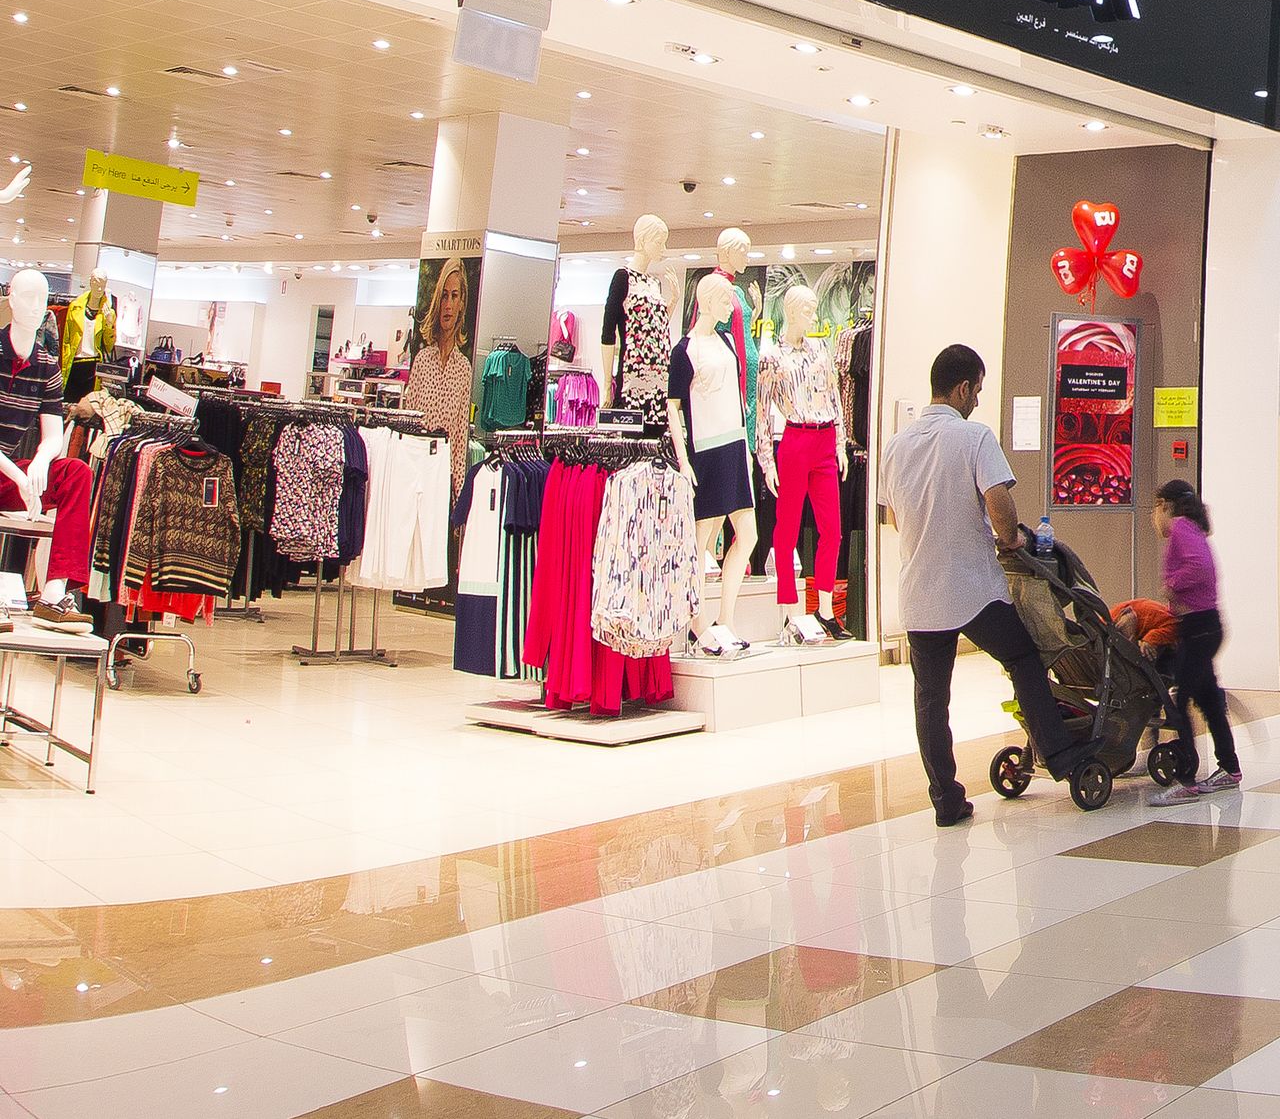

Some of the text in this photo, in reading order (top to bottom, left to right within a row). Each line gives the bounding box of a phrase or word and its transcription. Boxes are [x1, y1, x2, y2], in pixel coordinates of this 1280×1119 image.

[91, 163, 127, 179] Pay Here
[435, 237, 481, 251] SMART TOPS
[1067, 378, 1106, 386] VALENTINE'S
[620, 415, 634, 424] 225
